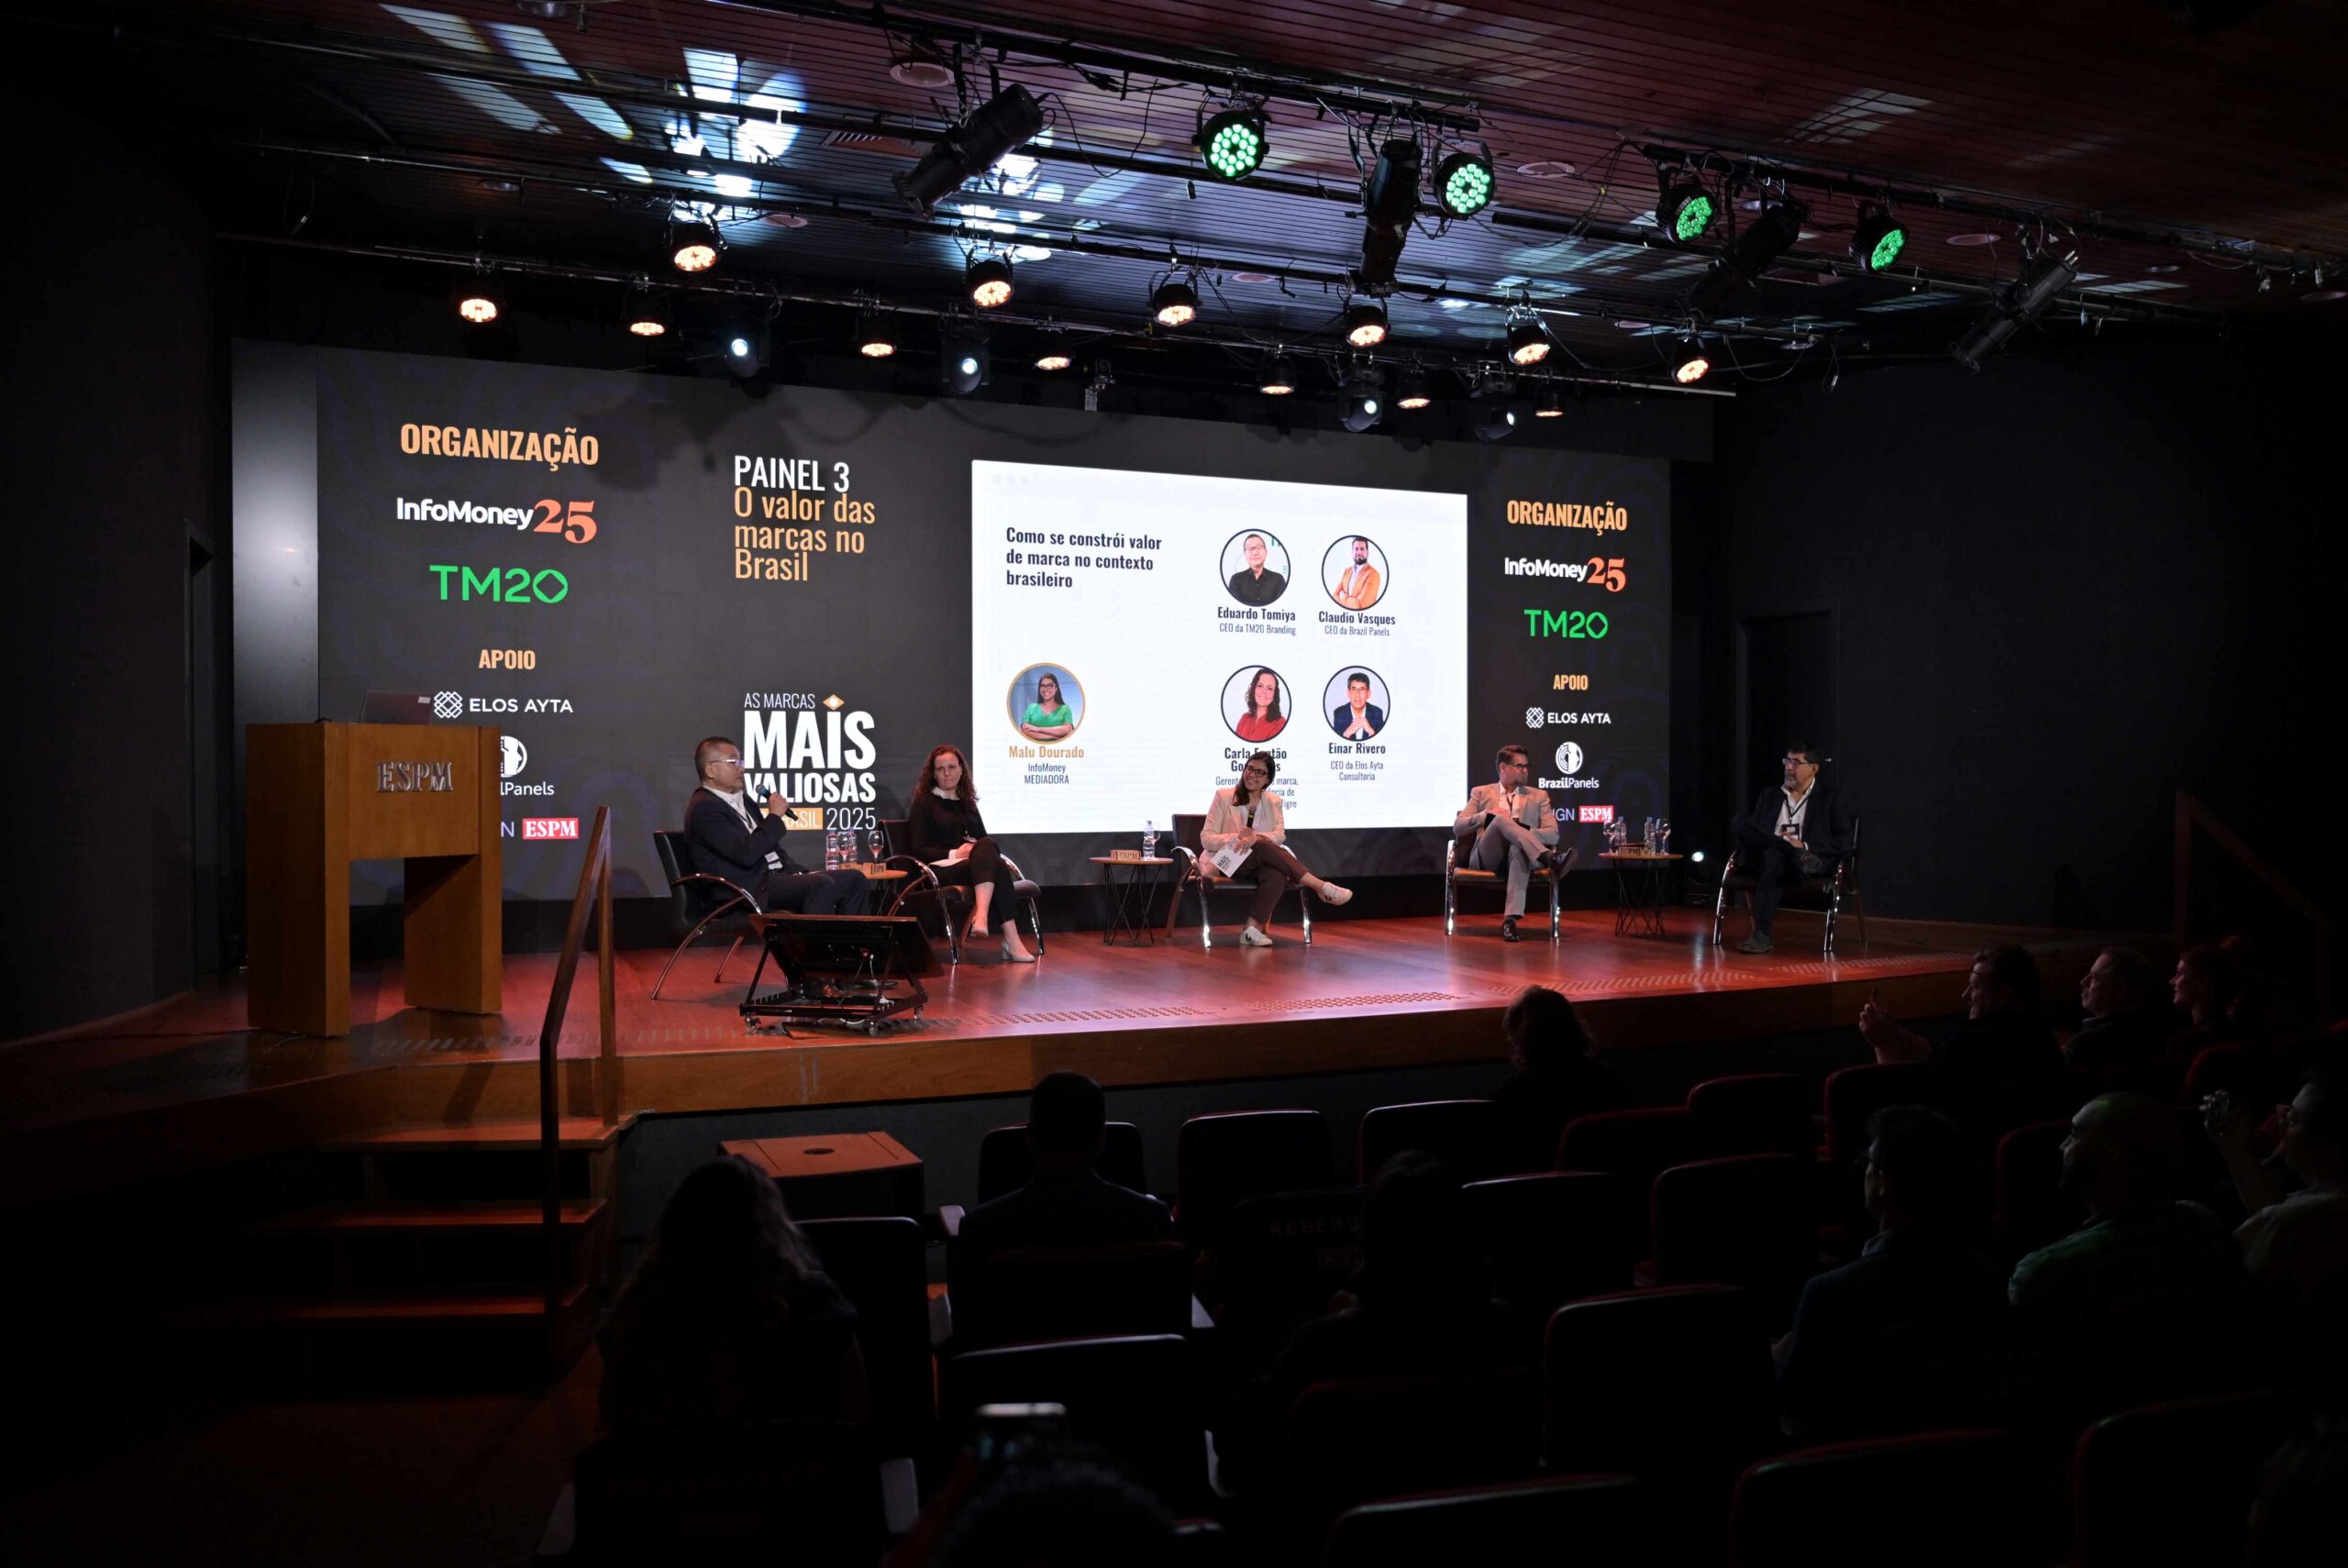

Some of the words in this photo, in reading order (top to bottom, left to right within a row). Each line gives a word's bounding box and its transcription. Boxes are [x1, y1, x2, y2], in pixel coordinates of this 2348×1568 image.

[400, 423, 599, 472] ORGANIZAÇÃO
[735, 455, 825, 491] PAINEL
[833, 461, 850, 492] 3
[735, 486, 753, 518] O
[761, 490, 825, 522] valor
[834, 493, 876, 525] das
[1507, 500, 1628, 536] ORGANIZAÇÃO
[735, 525, 827, 552] marcas
[836, 530, 865, 554] no
[1006, 526, 1046, 545] Como
[1049, 533, 1065, 546] se
[1069, 532, 1125, 548] constrói
[1129, 535, 1162, 550] valor
[735, 548, 808, 581] Brasil
[1006, 548, 1023, 565] de
[1027, 553, 1070, 567] marca
[1074, 555, 1091, 568] no
[1095, 555, 1154, 570] contexto
[429, 564, 569, 604] TM20
[1006, 569, 1073, 588] brasileiro
[1217, 606, 1258, 620] Eduardo
[1260, 608, 1296, 622] Tomiya
[1318, 611, 1355, 624] Claudio
[1357, 612, 1396, 627] Vasques
[1219, 623, 1234, 633] CEO
[1235, 624, 1244, 633] da
[1246, 624, 1265, 634] TM20
[1267, 624, 1296, 636] Branding
[1324, 625, 1338, 635] CEO
[1339, 625, 1348, 635] da
[1349, 626, 1368, 636] Brazil
[1369, 626, 1390, 637] Panels
[1523, 609, 1609, 639] TM20
[478, 648, 537, 670] APOIO
[1553, 674, 1589, 691] APOIO
[469, 698, 519, 713] ELOS
[524, 699, 574, 713] AYTA
[744, 692, 760, 709] AS
[763, 693, 816, 709] MARCAS
[1547, 712, 1578, 724] ELOS
[1580, 712, 1611, 724] AYTA
[744, 710, 877, 770] MAIS
[1328, 742, 1355, 755] Einar
[1356, 743, 1387, 755] Rivero
[1008, 745, 1036, 758] Malu
[1038, 745, 1085, 758] Dourado
[1224, 747, 1251, 759] Carla
[1027, 763, 1067, 774] InfoMoney
[1330, 761, 1344, 770] CEO
[1346, 760, 1354, 770] da
[1355, 760, 1368, 770] Elos
[1369, 760, 1384, 771] Ayta
[376, 761, 454, 793] ESPM
[1024, 774, 1070, 785] MEDIADORA
[1215, 776, 1239, 786] Gerent
[1276, 778, 1299, 787] marca,
[1338, 771, 1376, 781] Consultoria
[1538, 778, 1600, 790] BrazilPanels
[1286, 788, 1295, 797] de
[826, 807, 877, 831] 2025
[1579, 808, 1612, 822] ESPM
[524, 820, 577, 838] ESPM
